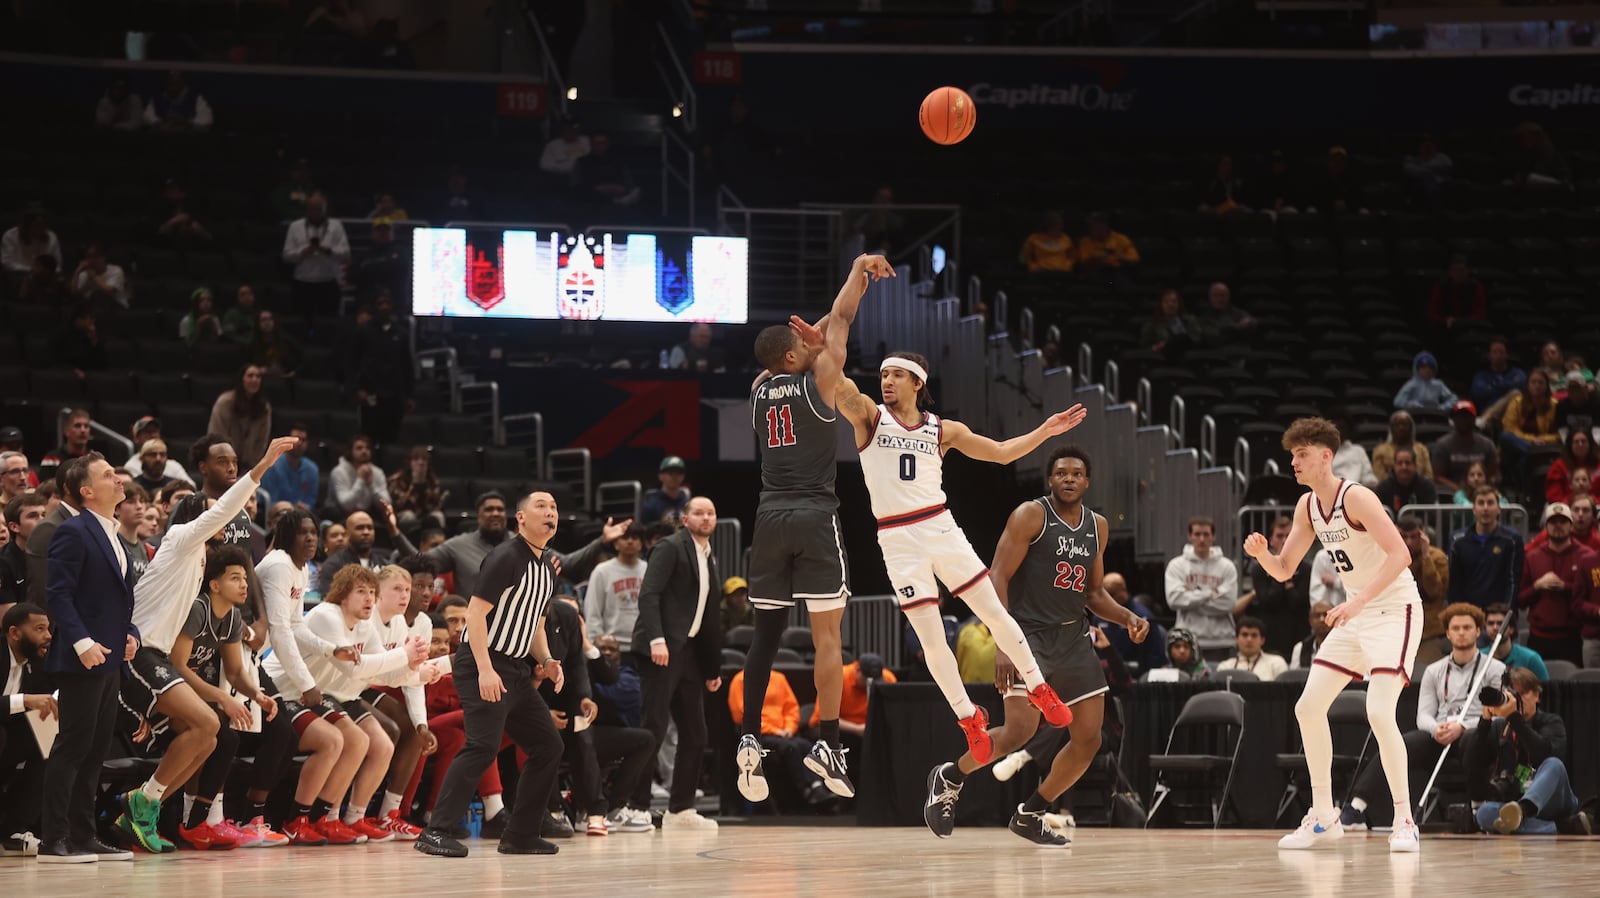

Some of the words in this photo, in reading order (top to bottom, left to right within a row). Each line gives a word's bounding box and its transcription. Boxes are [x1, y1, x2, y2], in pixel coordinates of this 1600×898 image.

[703, 60, 735, 78] 118
[506, 92, 539, 111] 119
[768, 383, 802, 400] BROWN
[766, 404, 797, 449] 11
[877, 434, 939, 456] DAYTON
[900, 453, 916, 481] 0
[1068, 537, 1090, 559] Joe's
[1053, 561, 1087, 592] 22
